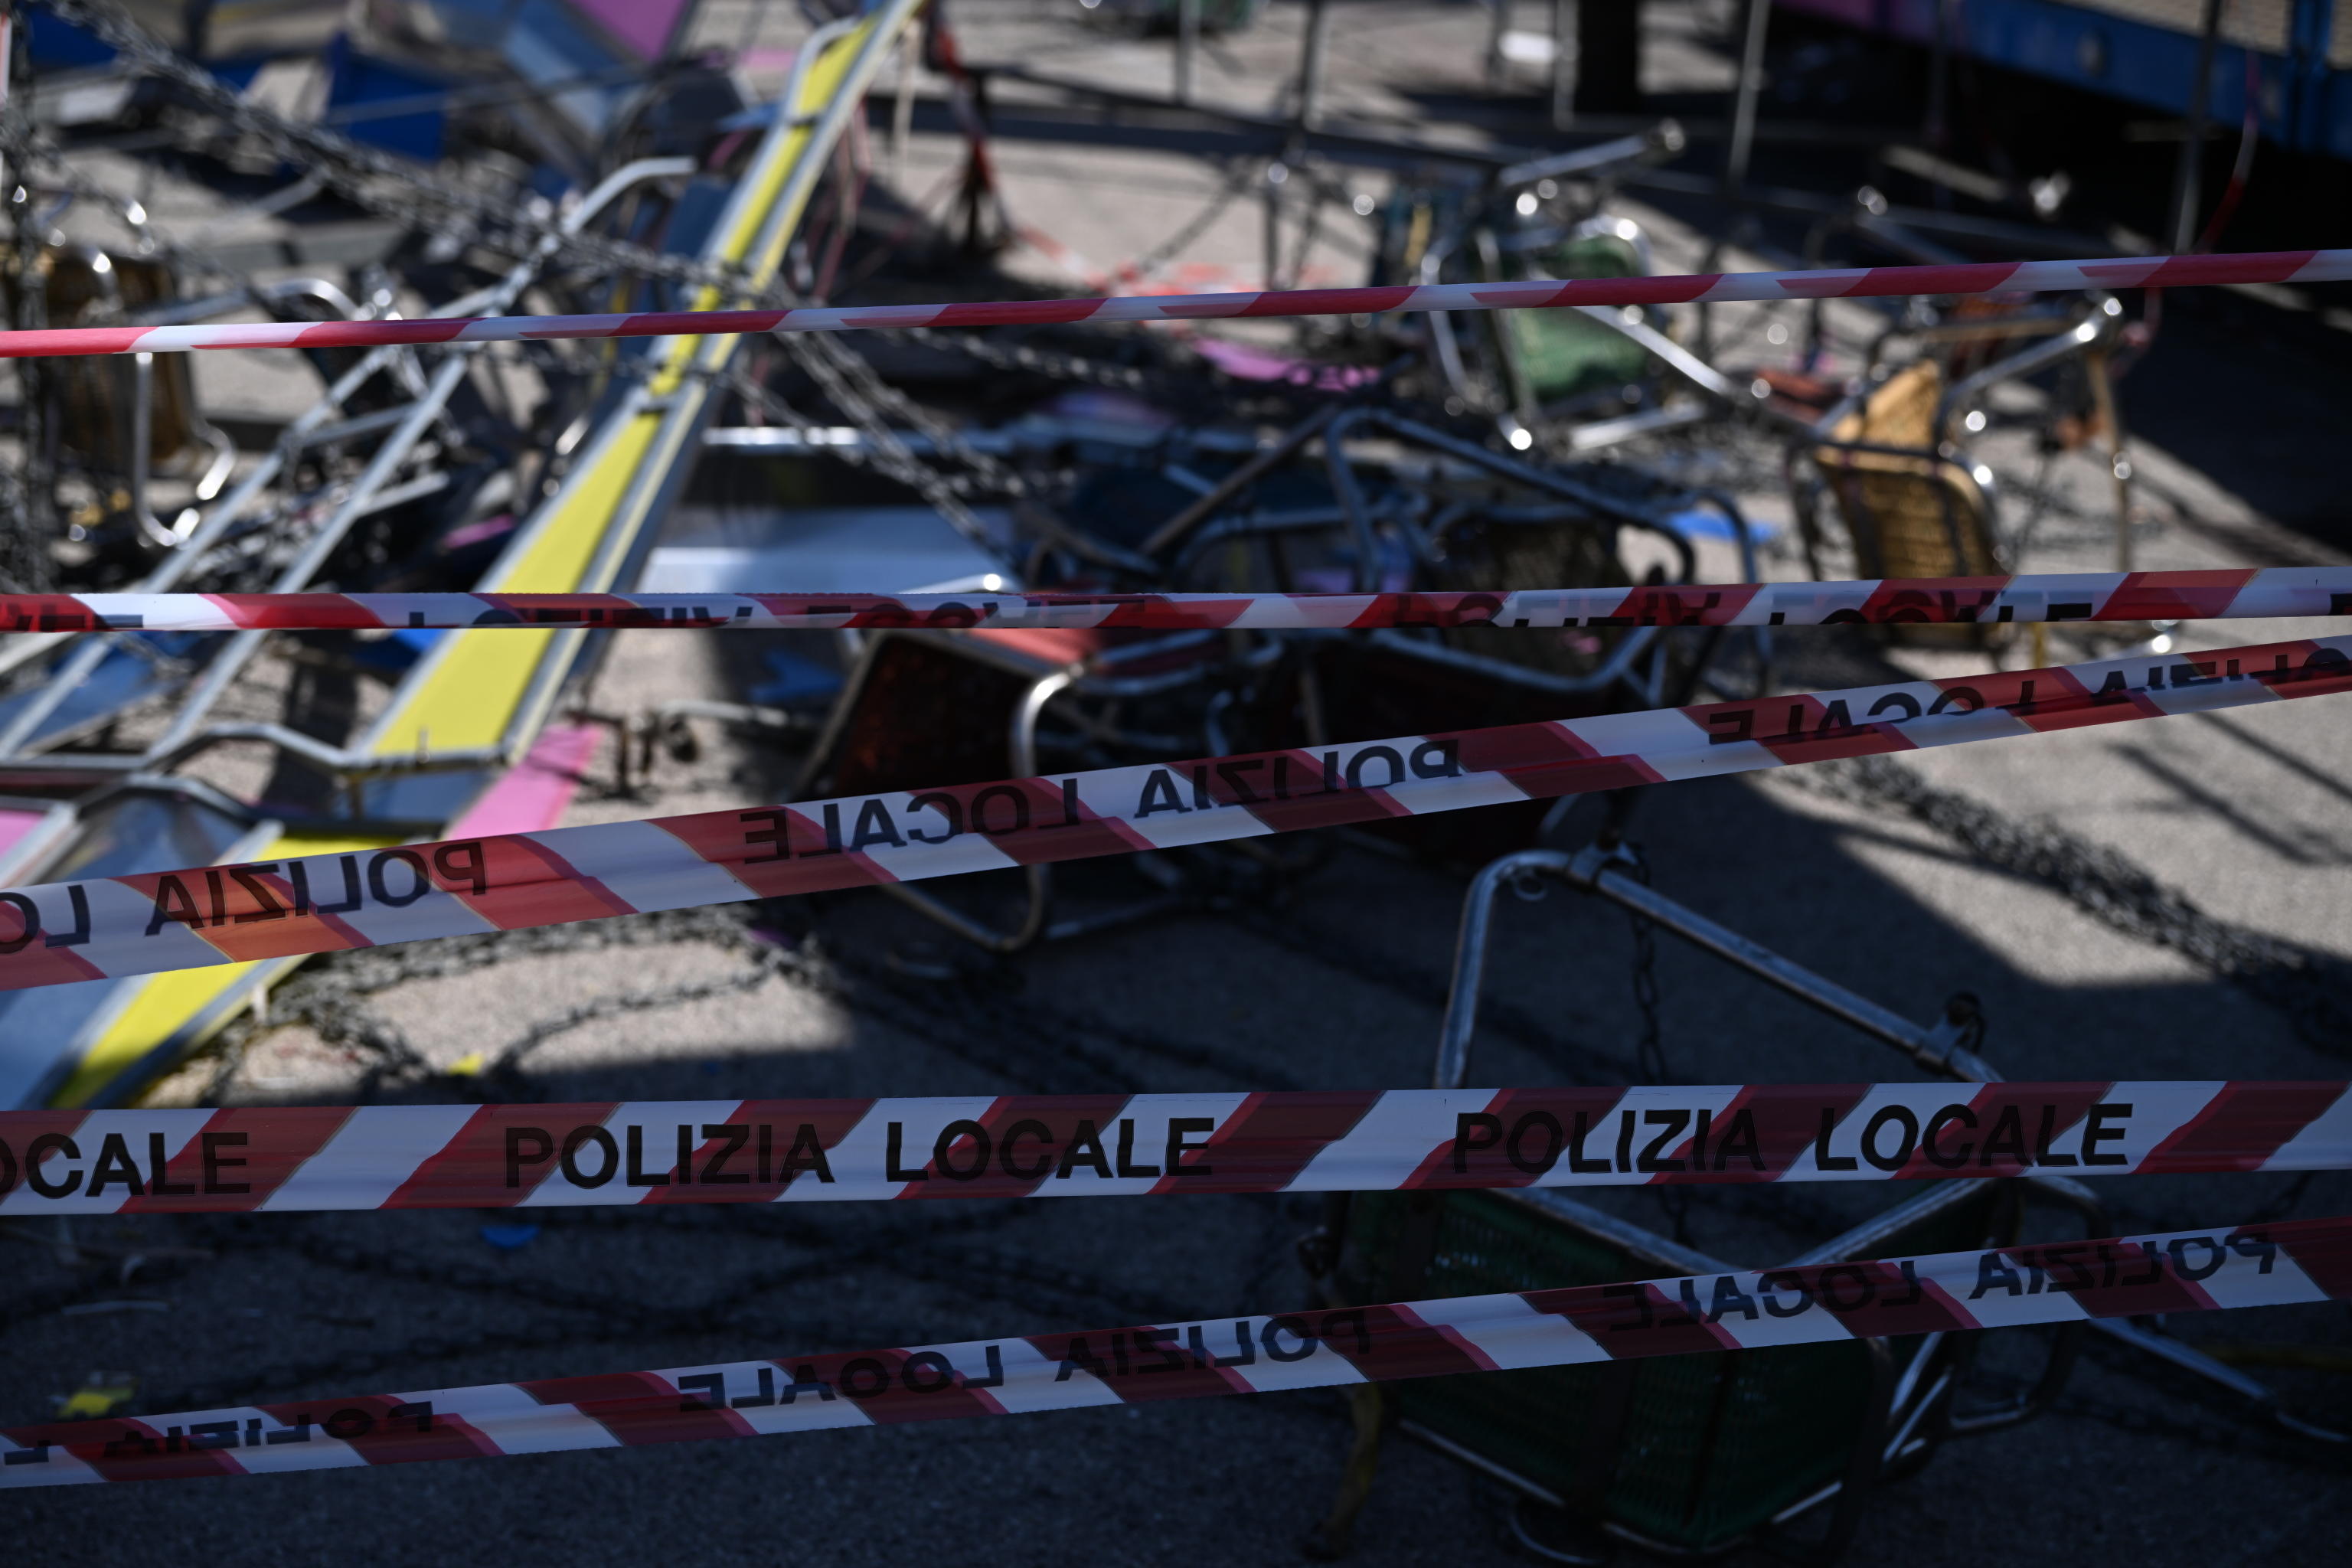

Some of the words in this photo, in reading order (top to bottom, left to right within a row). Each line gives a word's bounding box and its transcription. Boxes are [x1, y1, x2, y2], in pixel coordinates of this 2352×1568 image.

[0, 1132, 250, 1199] CALE
[505, 1123, 835, 1188] POLIZIA
[887, 1118, 1214, 1182] LOCALE
[1453, 1109, 1766, 1174] POLIZIA
[1816, 1103, 2133, 1172] LOCALE
